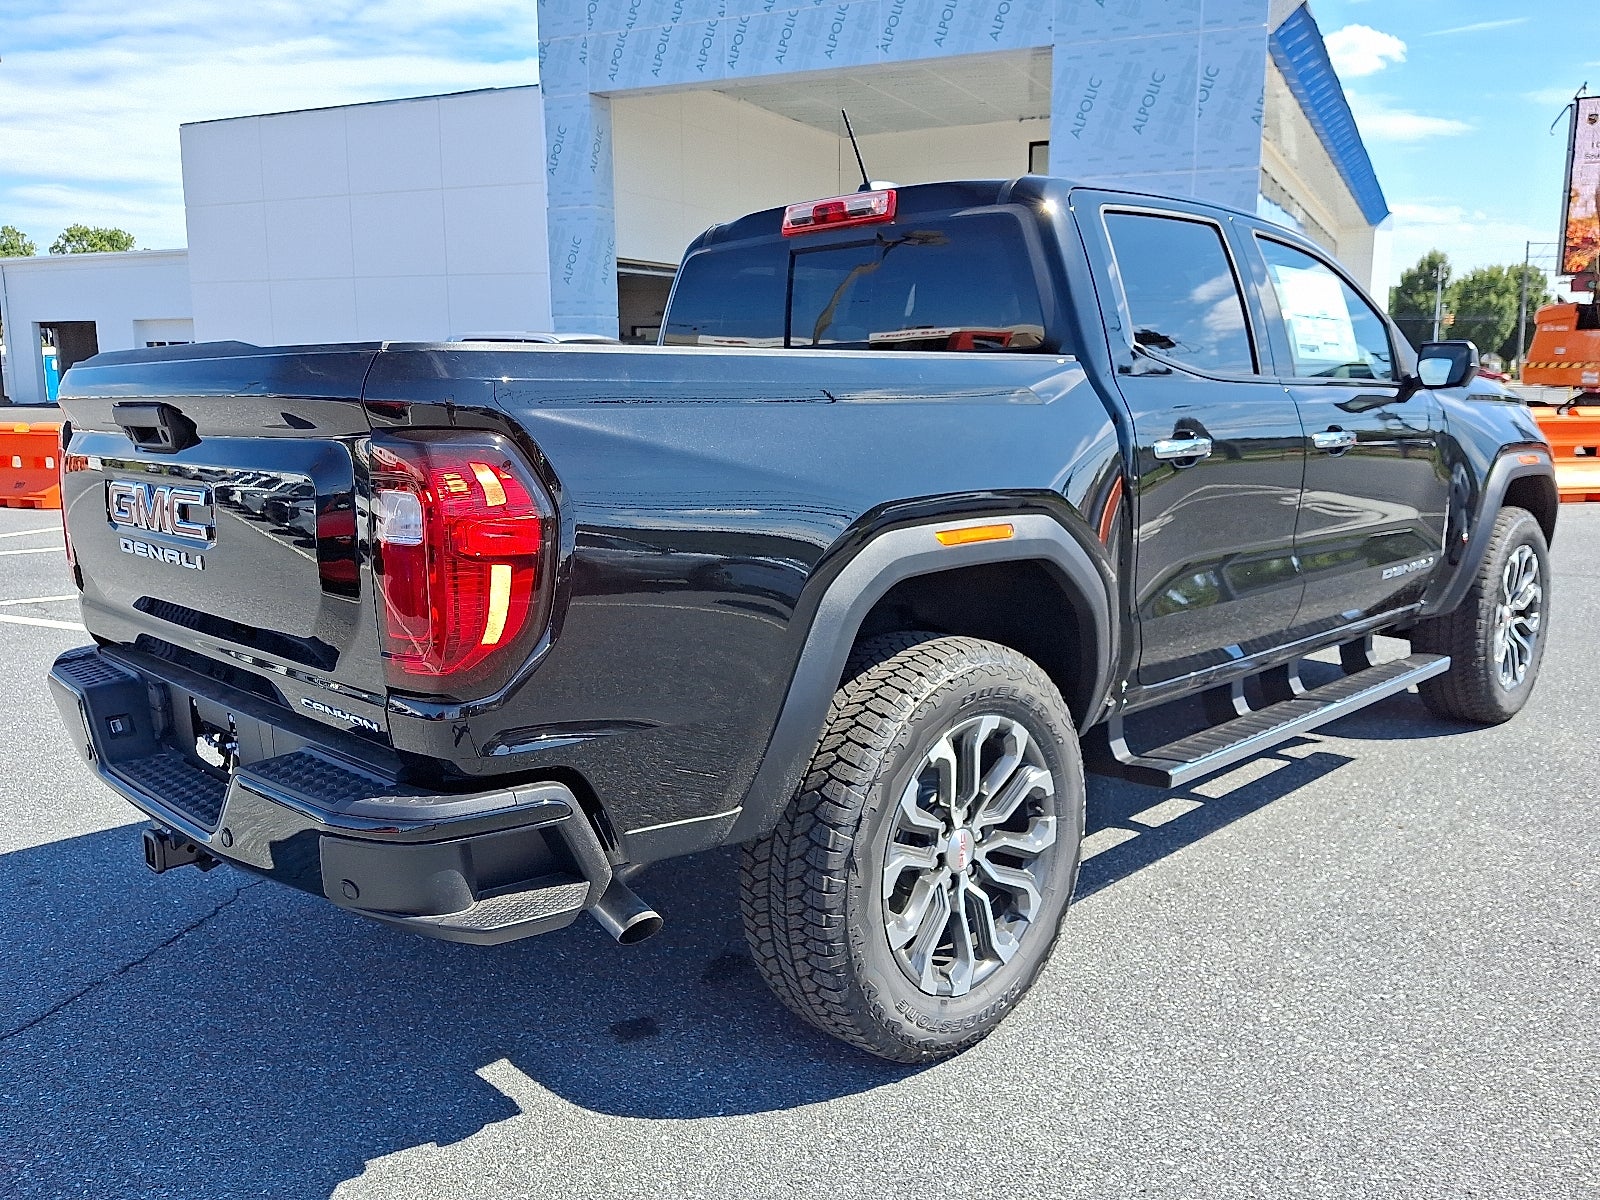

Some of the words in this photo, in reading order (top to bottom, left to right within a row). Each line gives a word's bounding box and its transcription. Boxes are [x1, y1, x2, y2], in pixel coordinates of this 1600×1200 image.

[608, 29, 628, 82] ALPOLIC
[652, 24, 673, 78] ALPOLIC
[696, 19, 719, 73] ALPOLIC
[727, 15, 751, 70] ALPOLIC
[775, 9, 799, 65] ALPOLIC
[824, 3, 850, 60] ALPOLIC
[1070, 74, 1103, 140] ALPOLIC
[1132, 67, 1166, 136] ALPOLIC
[548, 125, 567, 176] ALPOLIC
[590, 125, 604, 173] ALPOLIC
[563, 236, 582, 285] ALPOLIC
[600, 237, 615, 285] ALPOLIC
[107, 480, 216, 542] GMC
[119, 537, 206, 571] DENALI
[299, 696, 381, 733] CANYON
[895, 976, 1022, 1034] BRIDGESTONE
